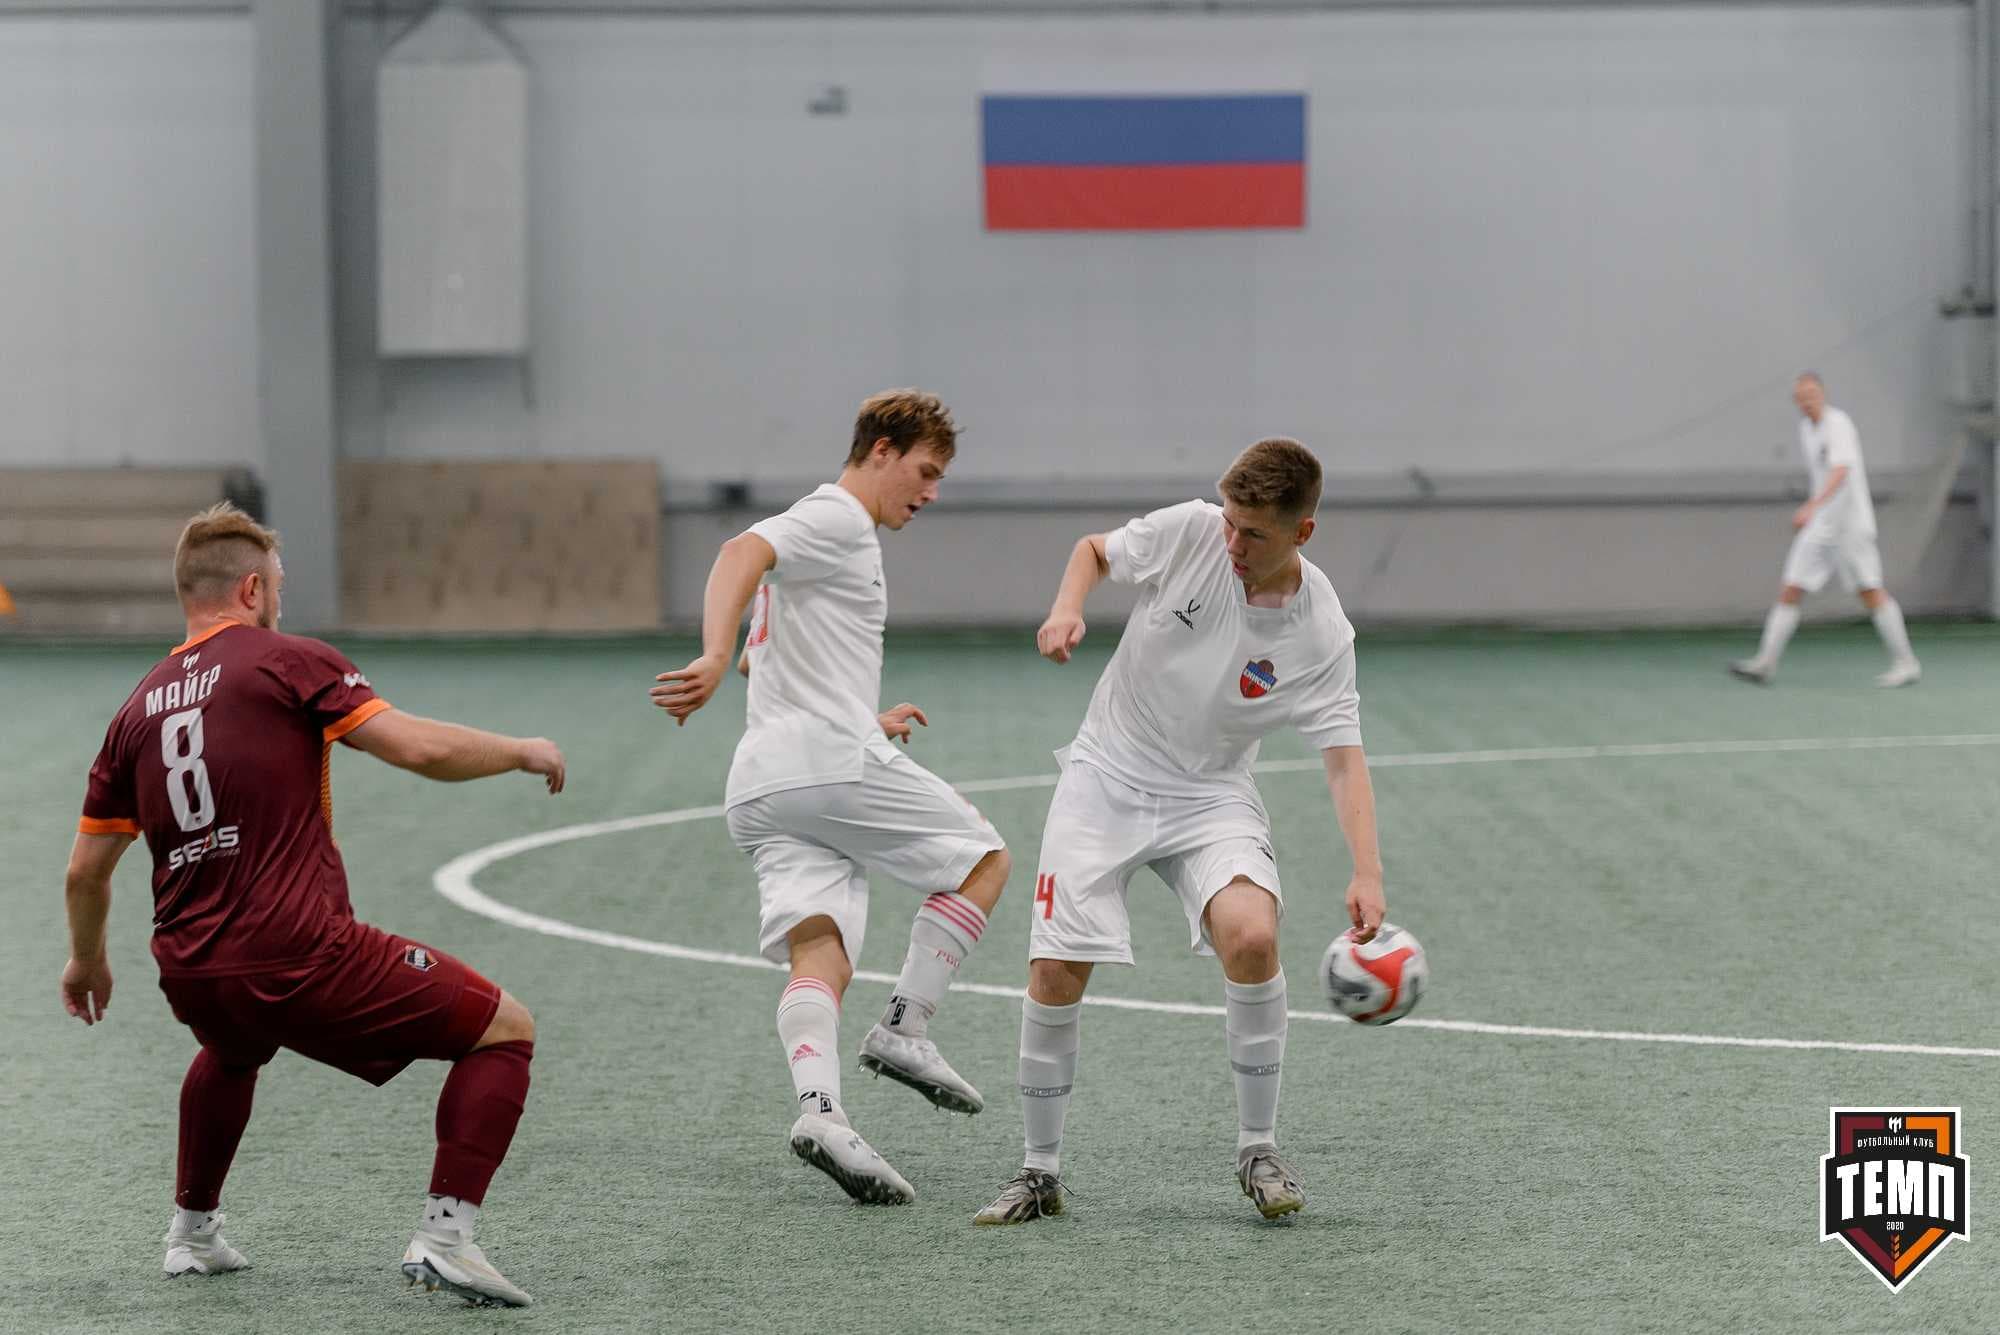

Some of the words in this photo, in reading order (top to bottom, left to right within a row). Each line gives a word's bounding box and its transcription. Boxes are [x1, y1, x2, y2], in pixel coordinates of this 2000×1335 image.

[145, 663, 222, 718] МАЙЕР
[160, 707, 216, 832] 8
[1035, 873, 1057, 920] 4
